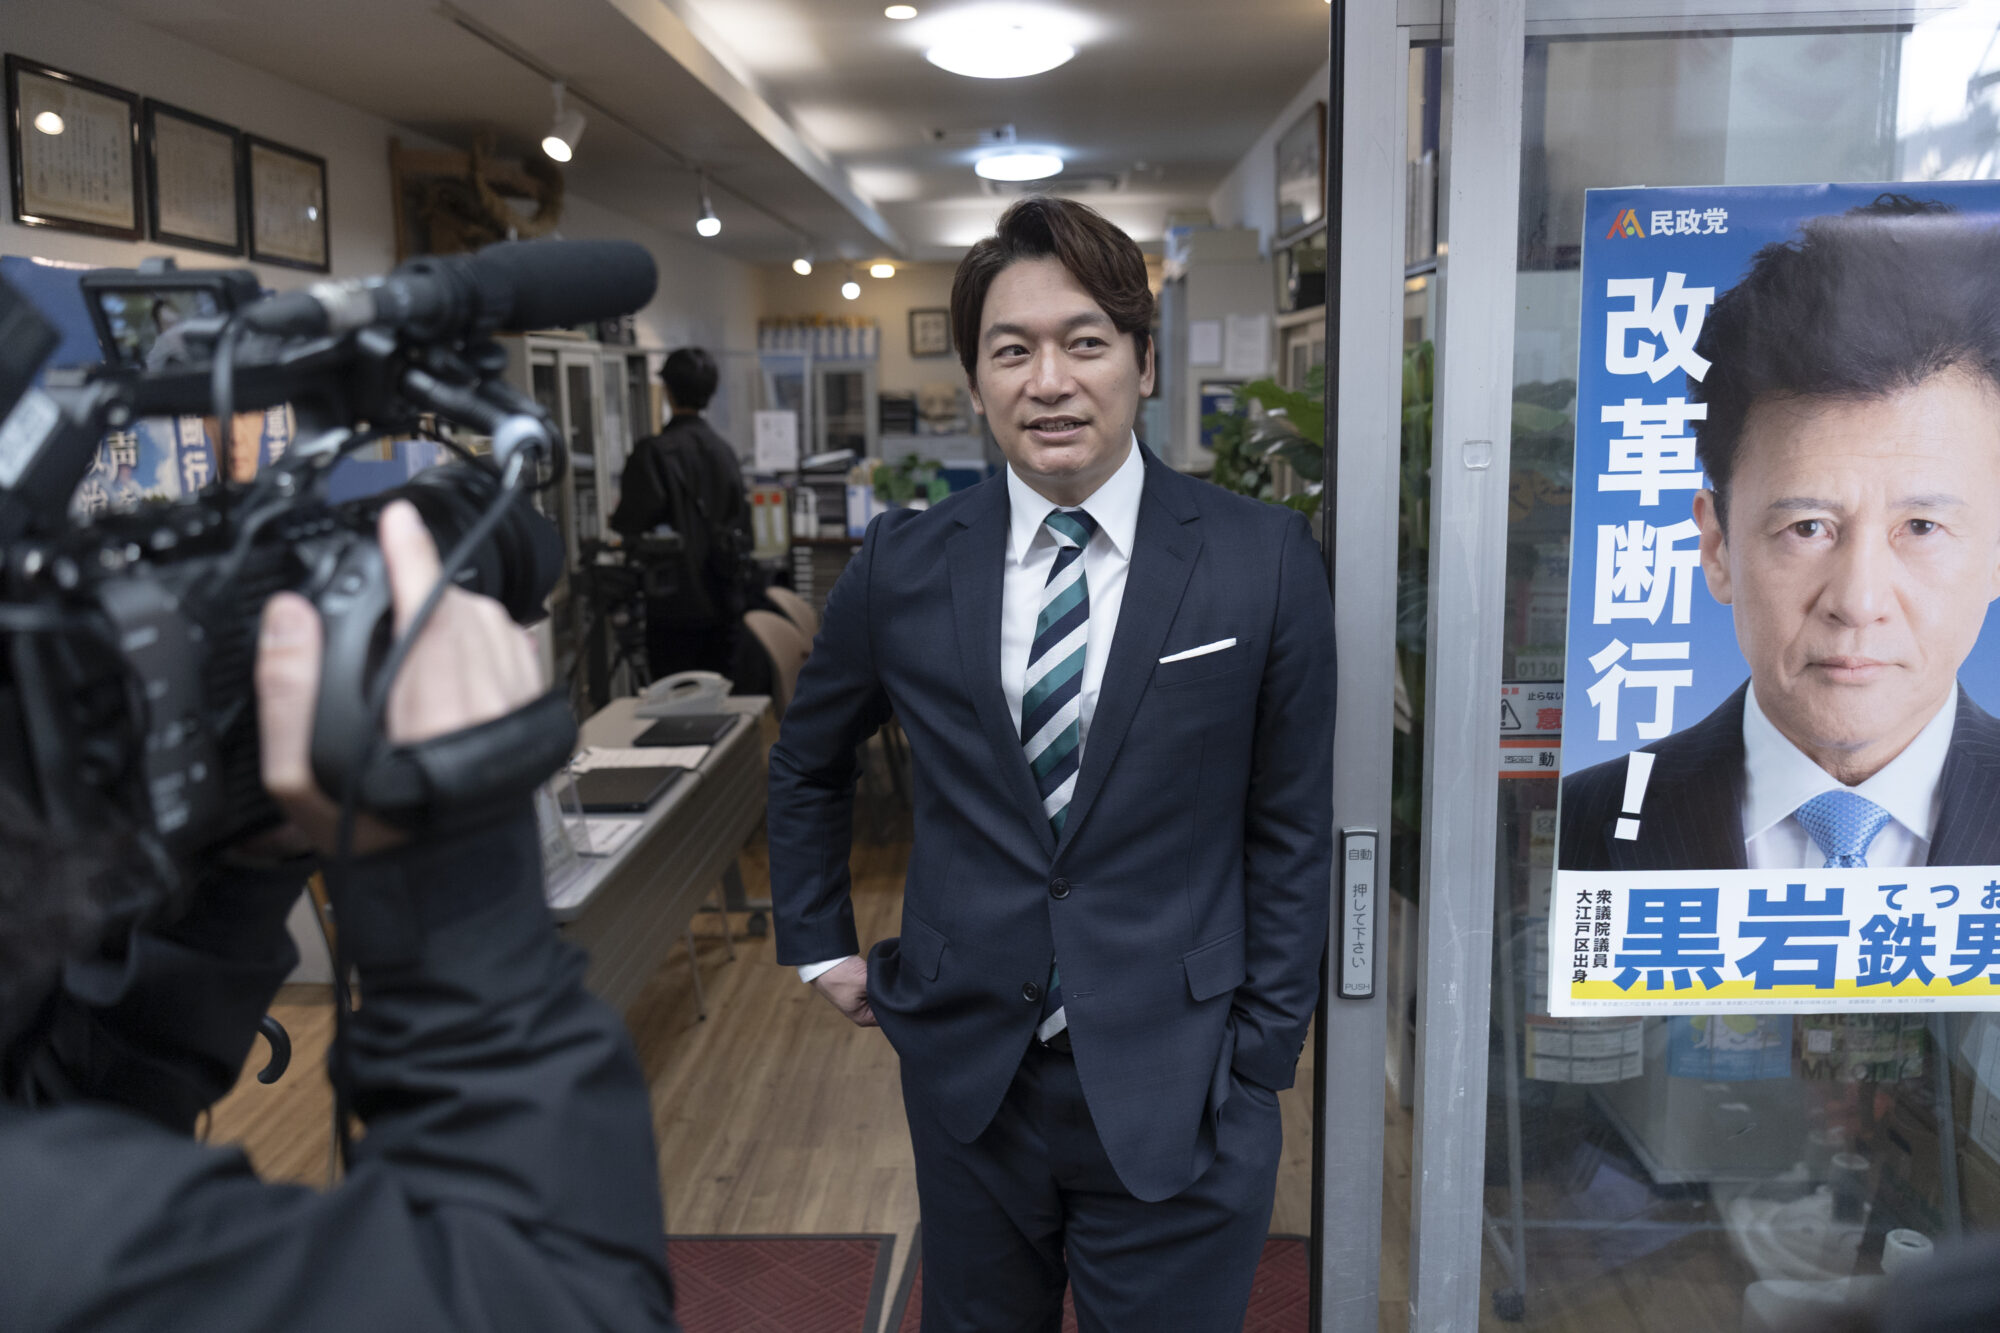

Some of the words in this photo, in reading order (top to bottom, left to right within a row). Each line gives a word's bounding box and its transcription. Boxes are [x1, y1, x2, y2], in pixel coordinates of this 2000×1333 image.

[1650, 208, 1728, 236] 民政党
[1538, 752, 1555, 767] 動
[1348, 848, 1372, 861] 自動
[1877, 880, 2000, 910] てつお
[1351, 883, 1368, 968] 押して下さい
[1572, 889, 1593, 983] 大江戸区出身
[1592, 889, 1612, 968] 衆議院議員
[1612, 883, 2000, 991] 黒岩鉄男
[1344, 983, 1370, 991] PUSH
